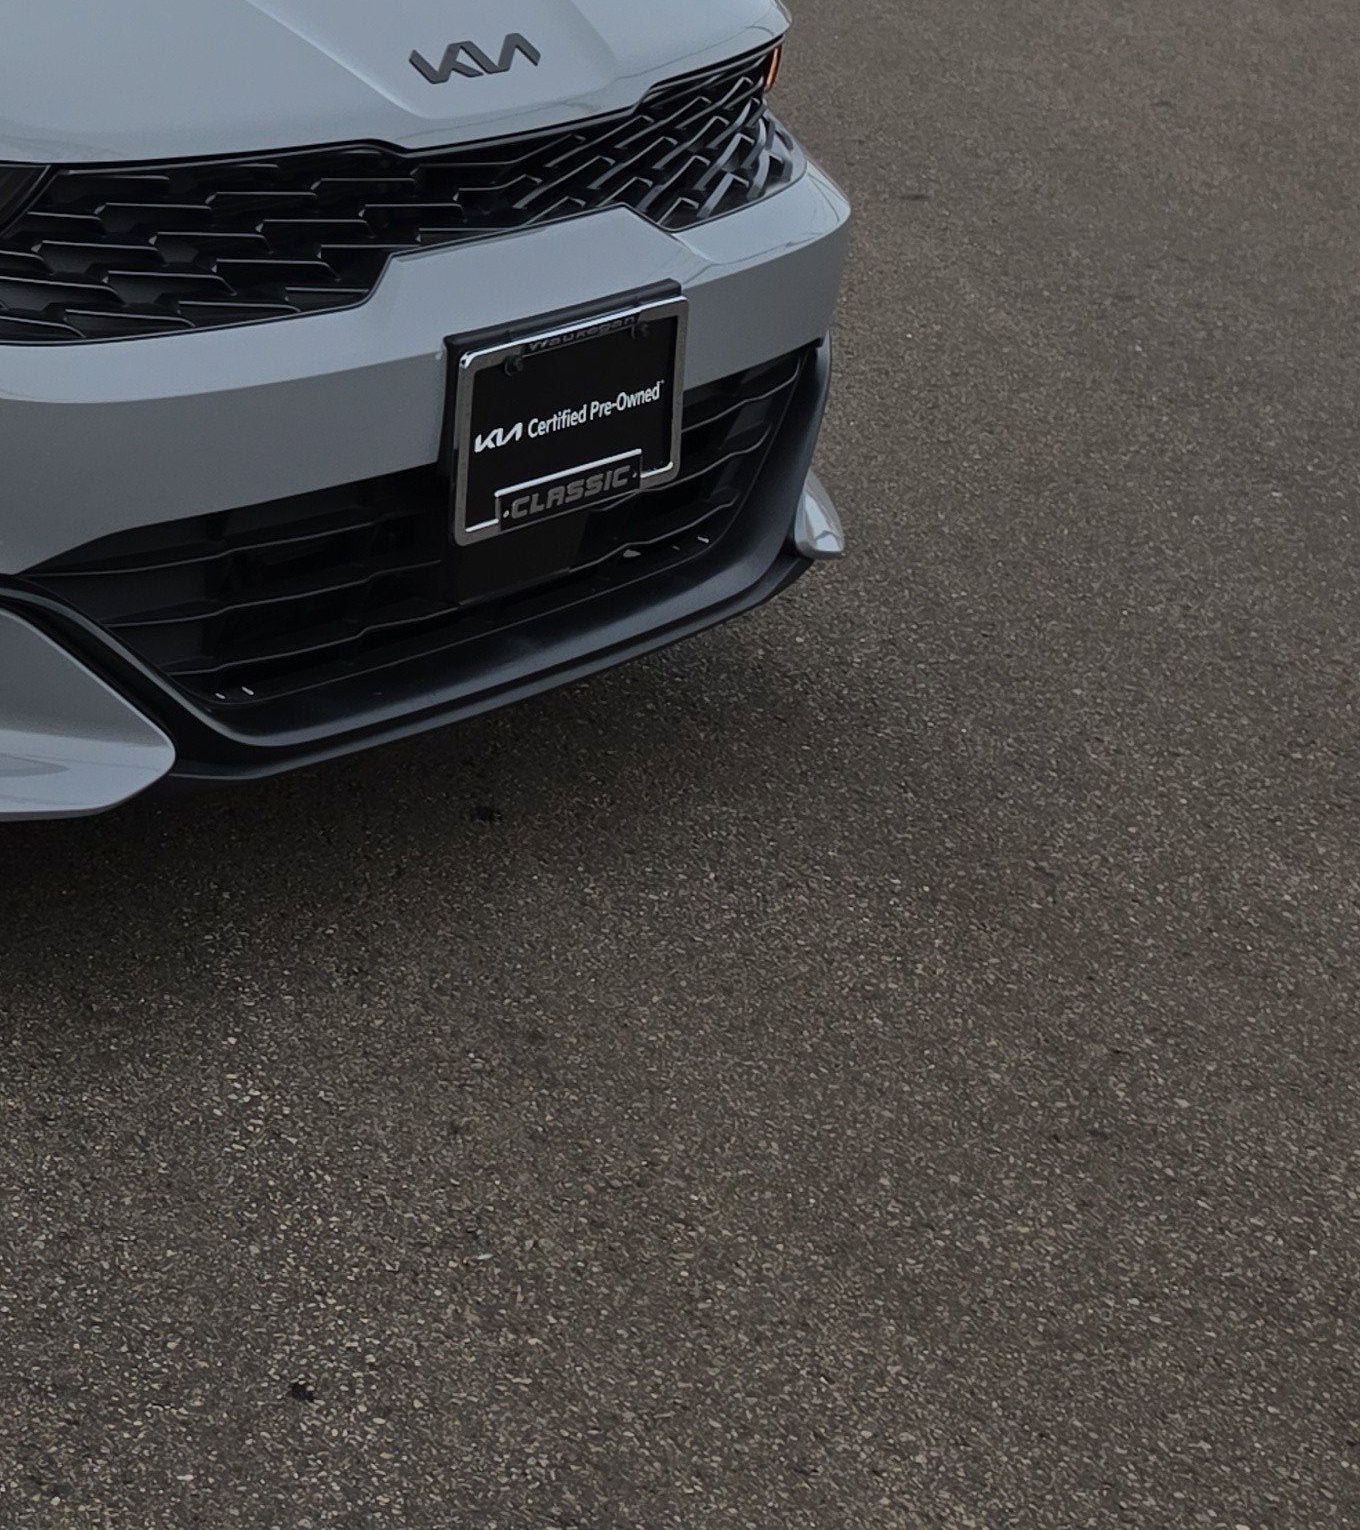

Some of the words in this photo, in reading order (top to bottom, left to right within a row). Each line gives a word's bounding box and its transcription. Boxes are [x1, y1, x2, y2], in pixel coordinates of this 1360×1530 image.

[408, 33, 541, 84] KIA
[474, 422, 523, 453] KIA
[527, 404, 588, 439] Certified
[589, 380, 661, 422] Pre-Owned
[511, 465, 631, 519] CLASSIC
